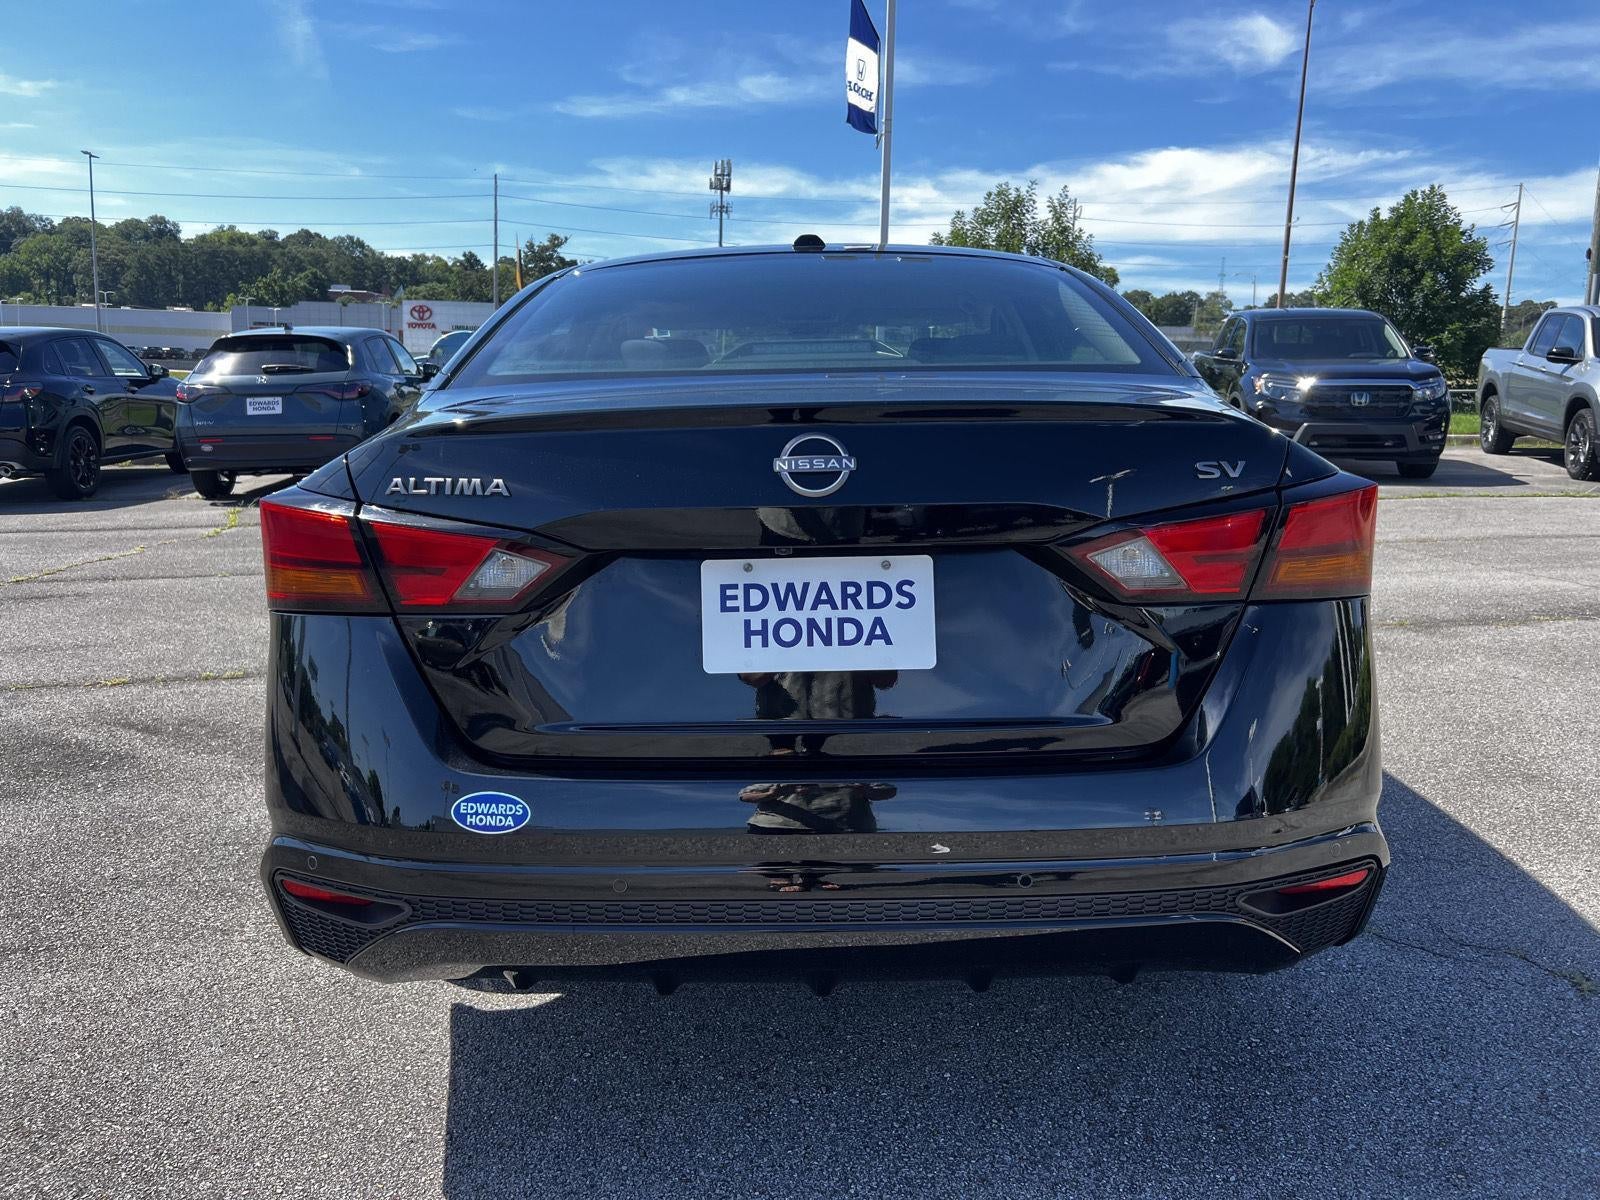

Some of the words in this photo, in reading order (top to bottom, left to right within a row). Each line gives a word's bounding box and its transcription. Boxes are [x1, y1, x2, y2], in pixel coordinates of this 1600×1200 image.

[776, 458, 855, 471] NISSAN
[1195, 460, 1246, 479] SV
[384, 476, 511, 497] ALTIMA
[719, 579, 917, 613] EDWARDS
[743, 616, 894, 648] HONDA
[460, 802, 524, 815] EDWARDS
[466, 814, 515, 827] HONDA
